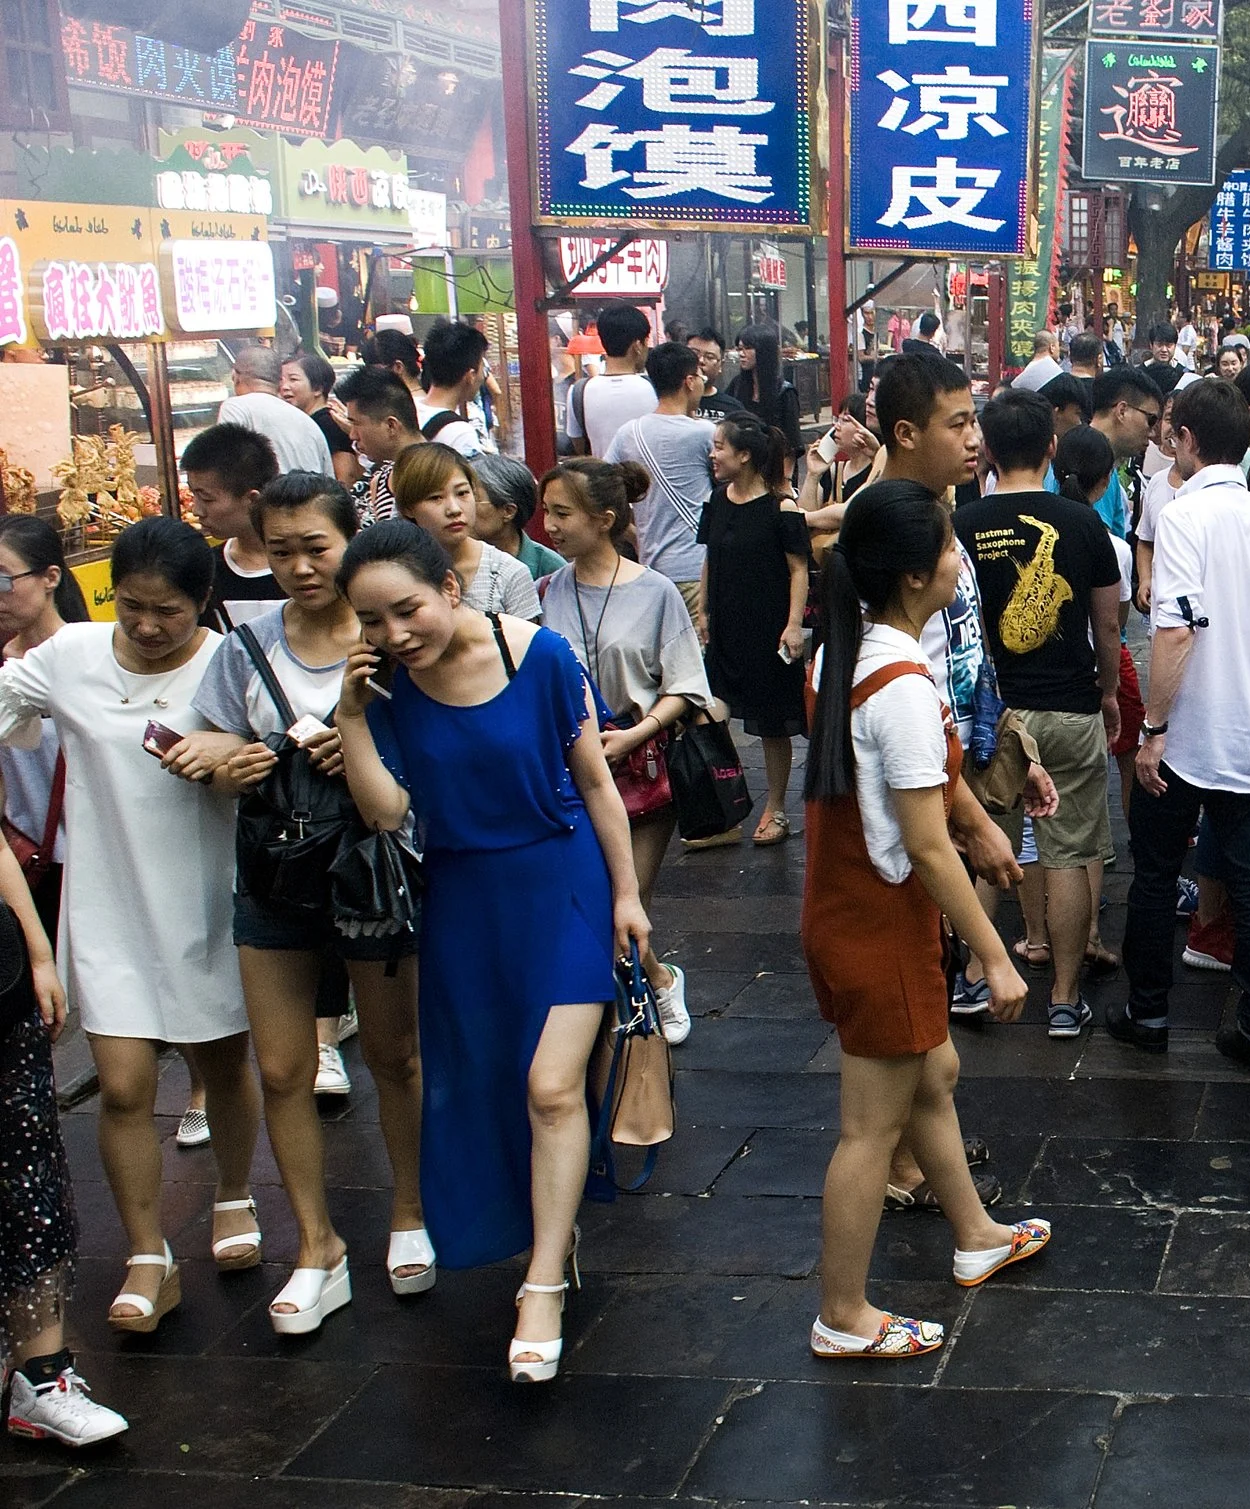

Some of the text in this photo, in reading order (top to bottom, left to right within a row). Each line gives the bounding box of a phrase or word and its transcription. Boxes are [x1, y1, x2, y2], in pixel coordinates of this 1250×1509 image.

[876, 0, 1009, 232] 西凉皮
[1118, 156, 1181, 170] 百年老店
[975, 529, 1014, 540] Eastman
[976, 538, 1026, 551] Saxophone
